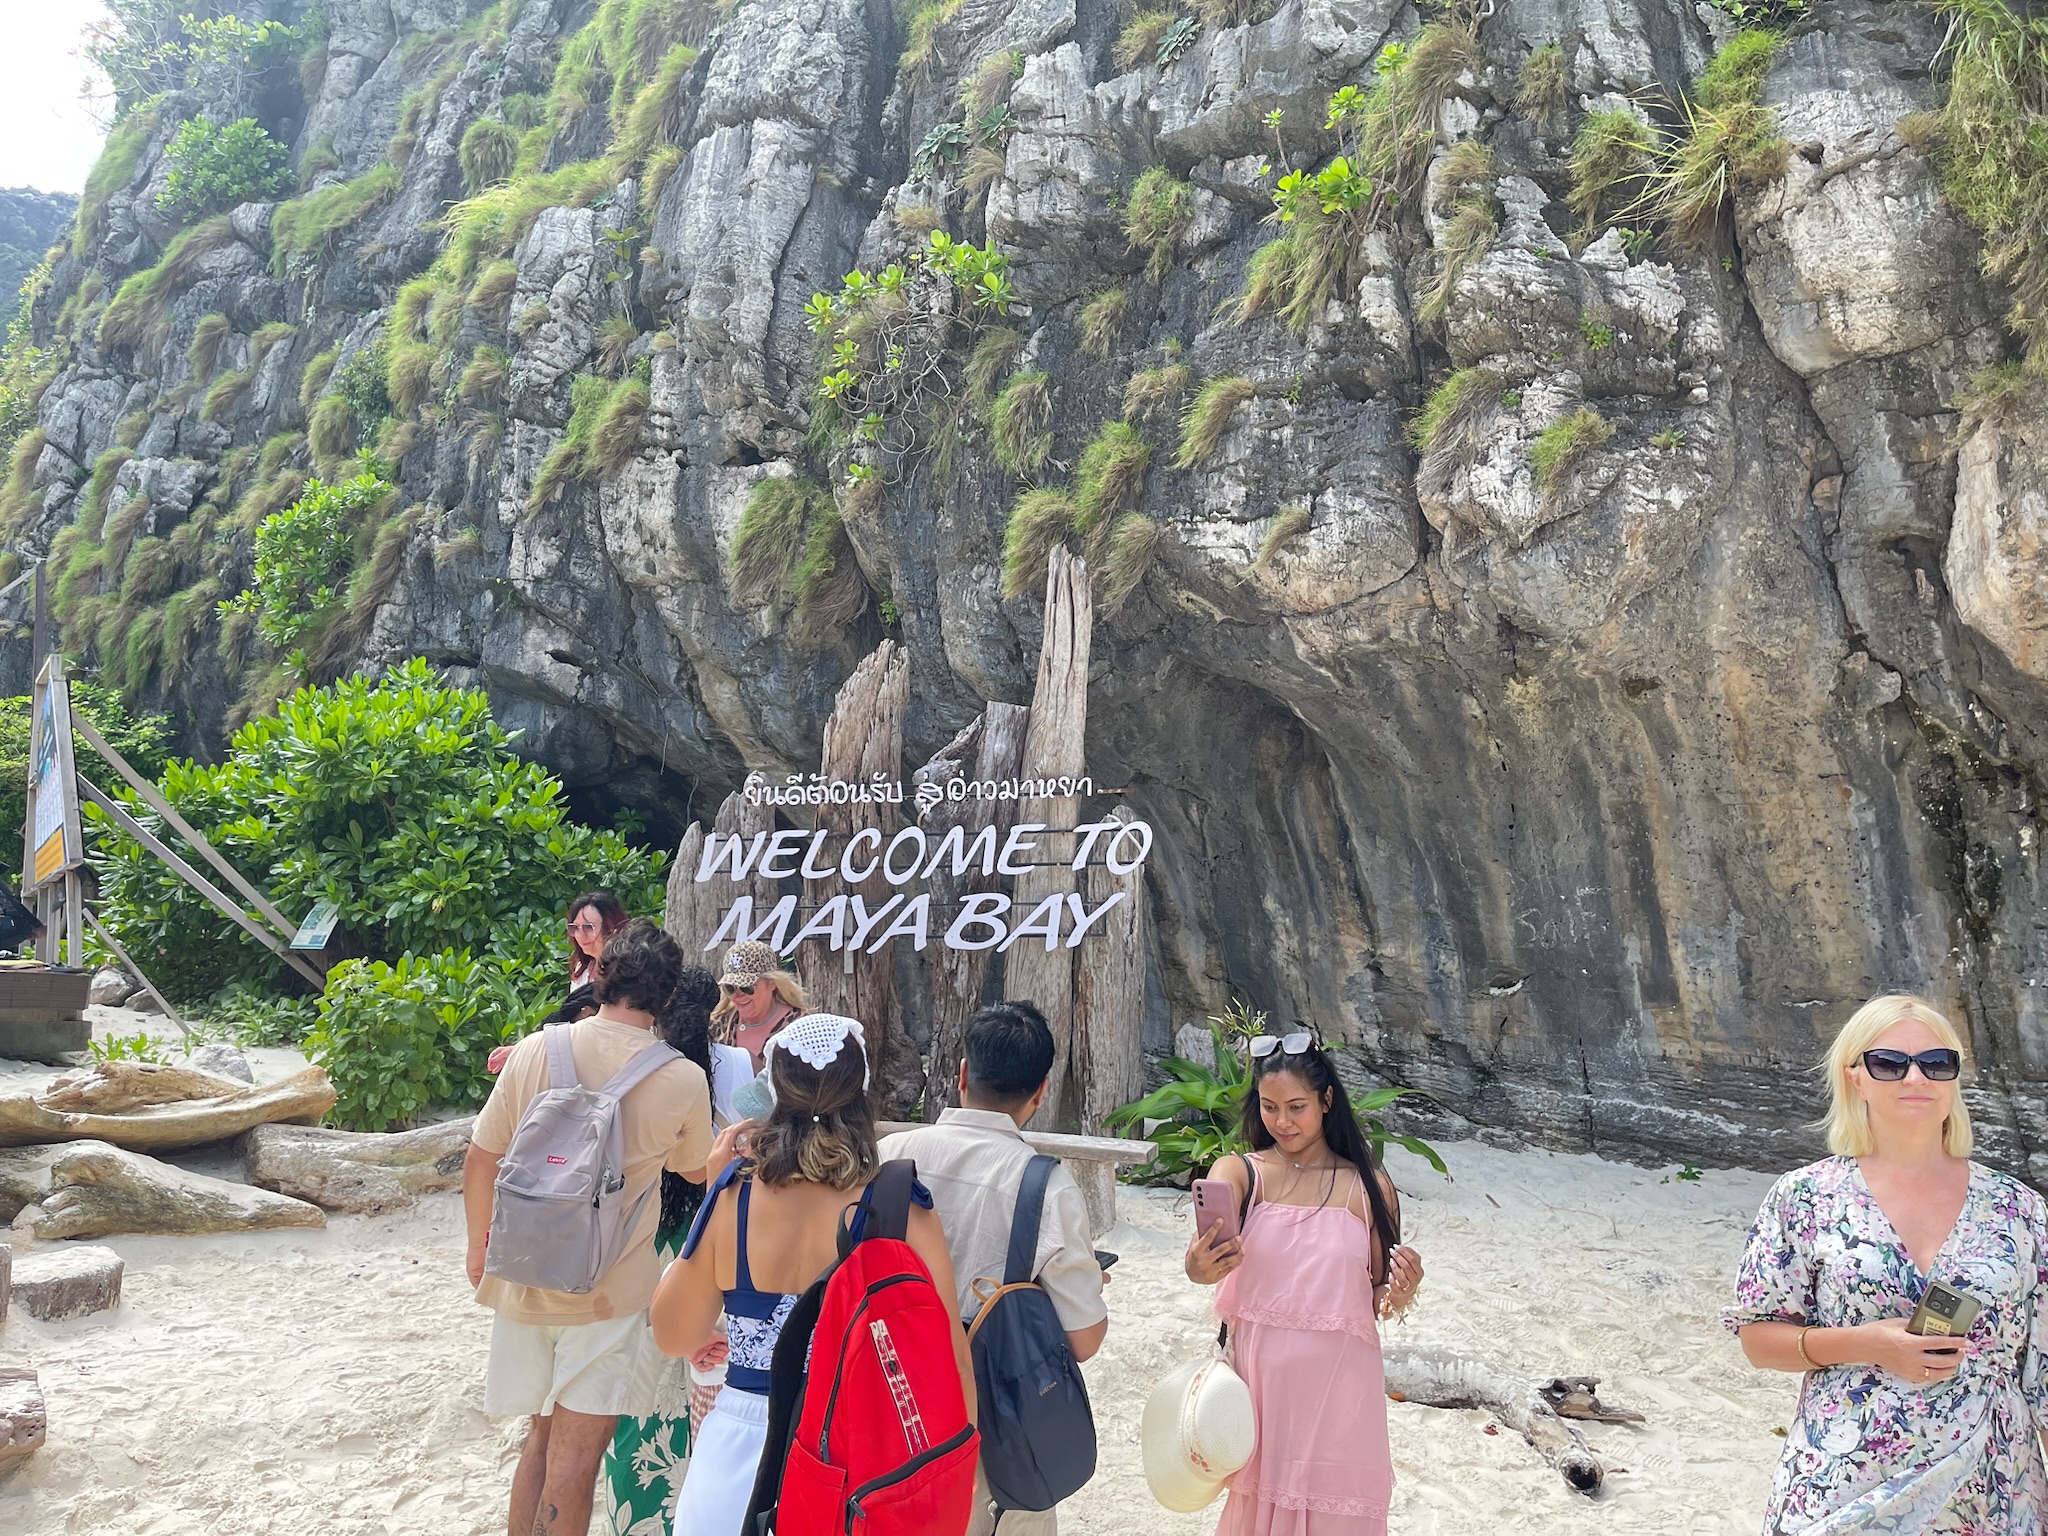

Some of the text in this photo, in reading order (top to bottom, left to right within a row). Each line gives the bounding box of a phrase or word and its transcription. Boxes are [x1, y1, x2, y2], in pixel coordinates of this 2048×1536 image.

[744, 773, 903, 806] ยินดีต้อนรับ
[695, 821, 1153, 885] WELCOME TO
[704, 892, 1126, 957] MAYA BAY
